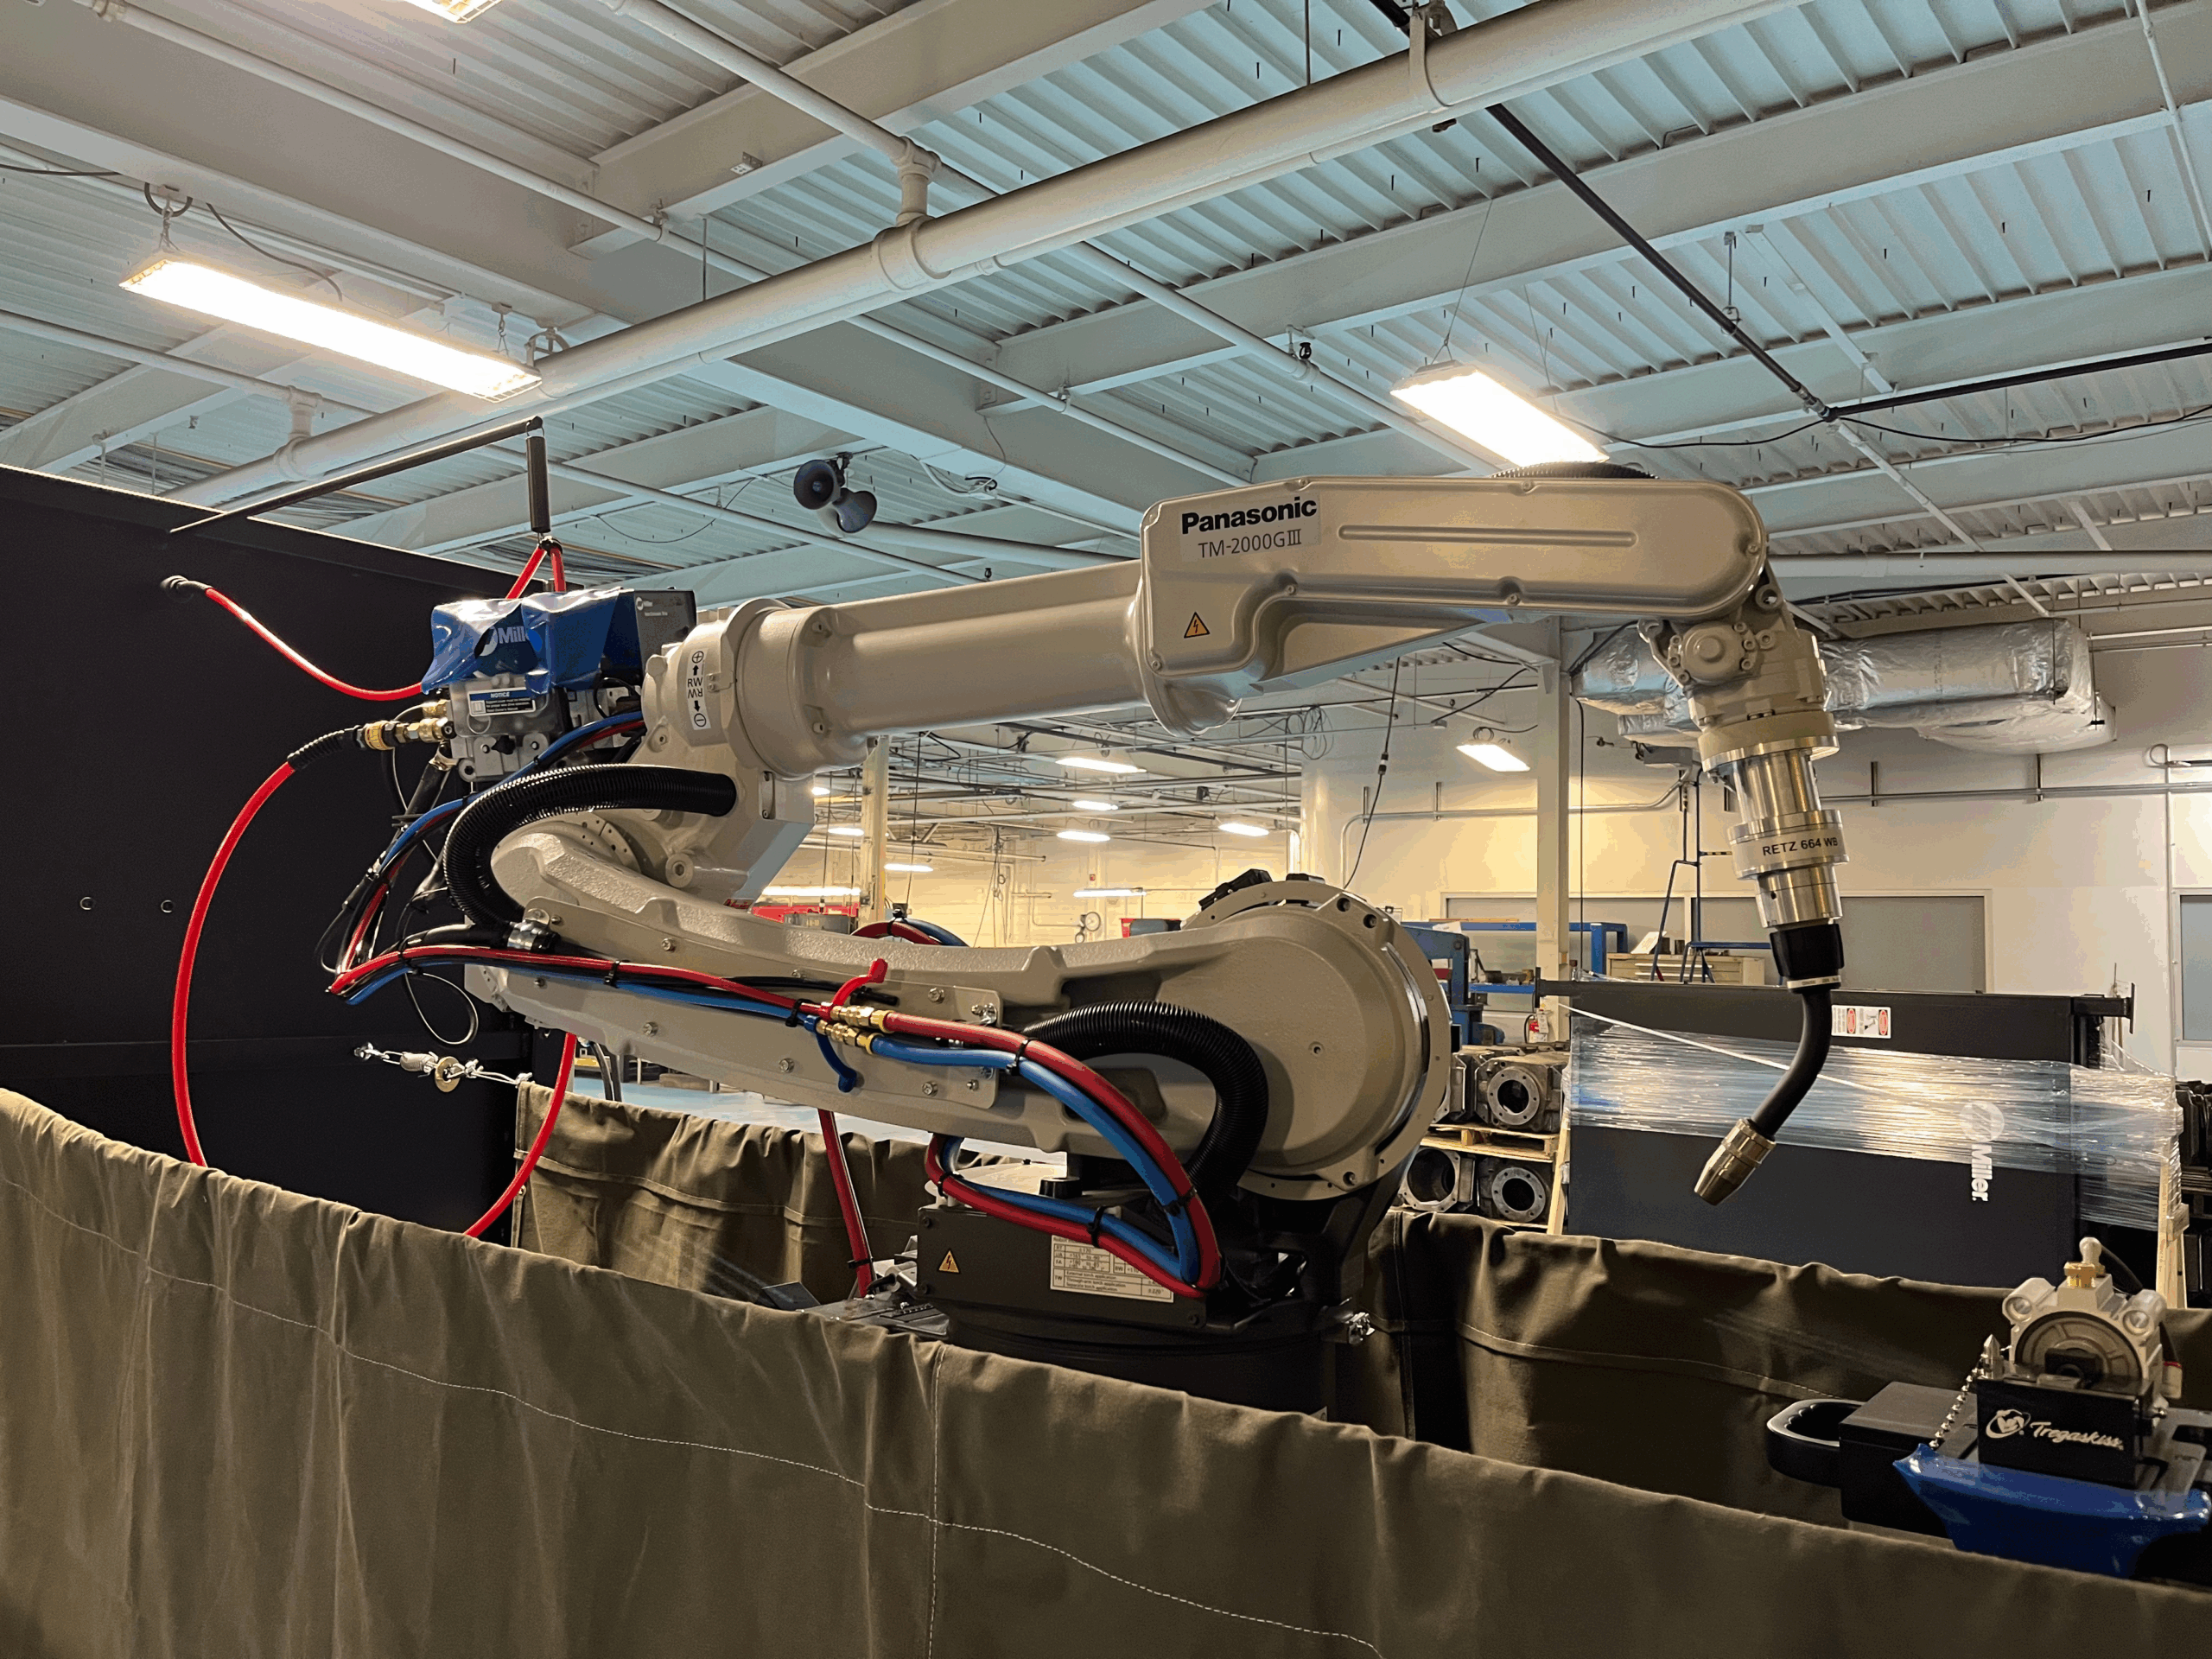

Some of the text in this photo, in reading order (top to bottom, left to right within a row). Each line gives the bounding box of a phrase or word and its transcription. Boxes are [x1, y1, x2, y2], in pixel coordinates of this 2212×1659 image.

[1181, 496, 1318, 535] Panasonic
[498, 626, 528, 645] Mill
[688, 677, 703, 688] RW
[1762, 836, 1839, 856] RETZ 664 WB
